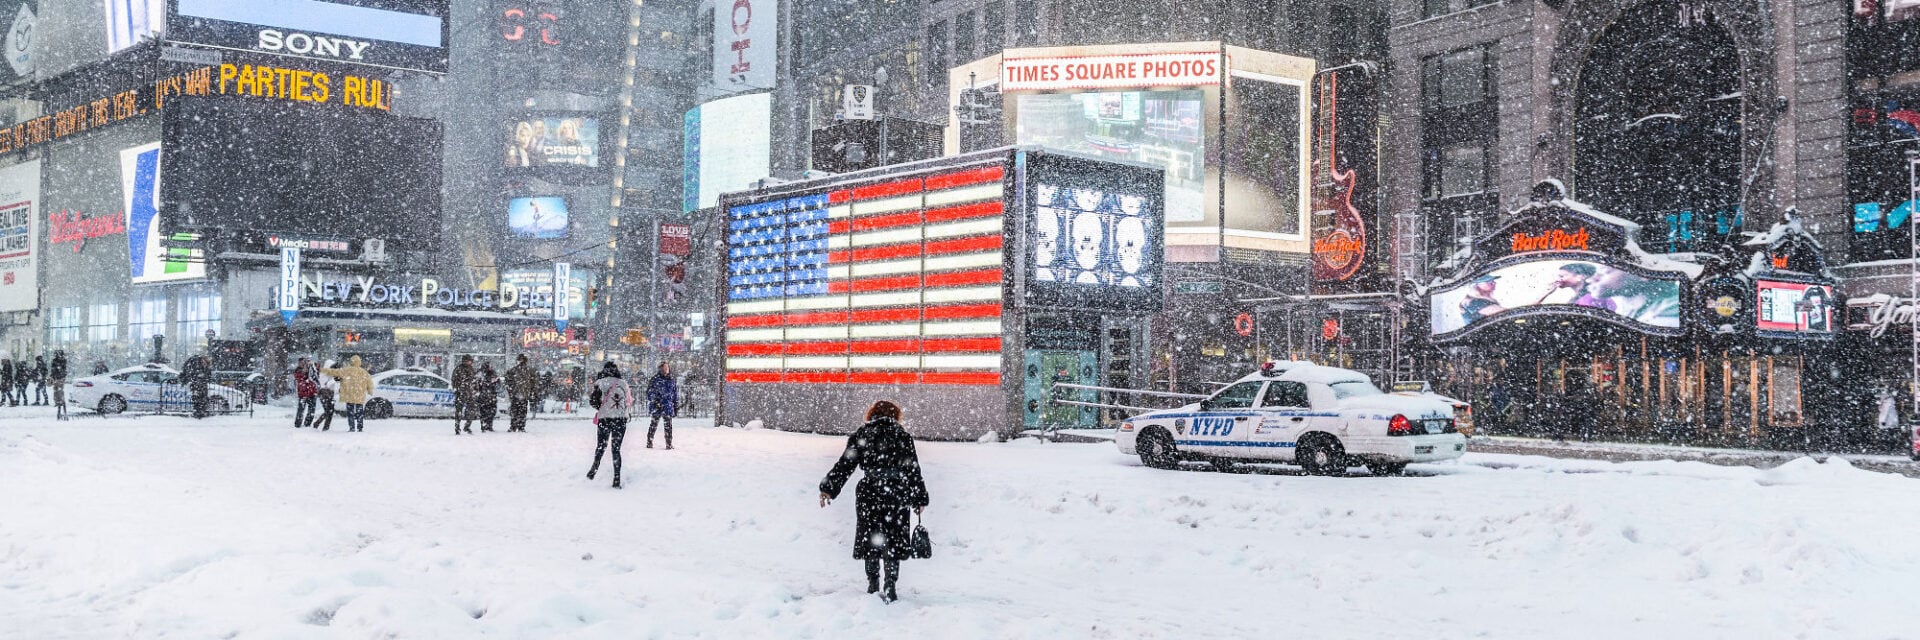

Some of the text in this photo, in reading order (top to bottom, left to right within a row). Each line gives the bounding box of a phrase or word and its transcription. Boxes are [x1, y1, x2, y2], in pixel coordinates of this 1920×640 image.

[258, 29, 370, 59] SONY
[220, 63, 330, 103] PARTIES
[1007, 59, 1216, 82] TIMES SQUARE PHOTOS
[543, 145, 592, 155] CRISIS
[49, 208, 124, 253] Walgreens
[1512, 227, 1589, 252] Hard Rock
[1314, 237, 1361, 254] Hard Rock
[286, 251, 296, 308] NYPD
[559, 264, 567, 318] NYPD
[433, 393, 455, 402] NYP
[1189, 417, 1234, 436] NYPD
